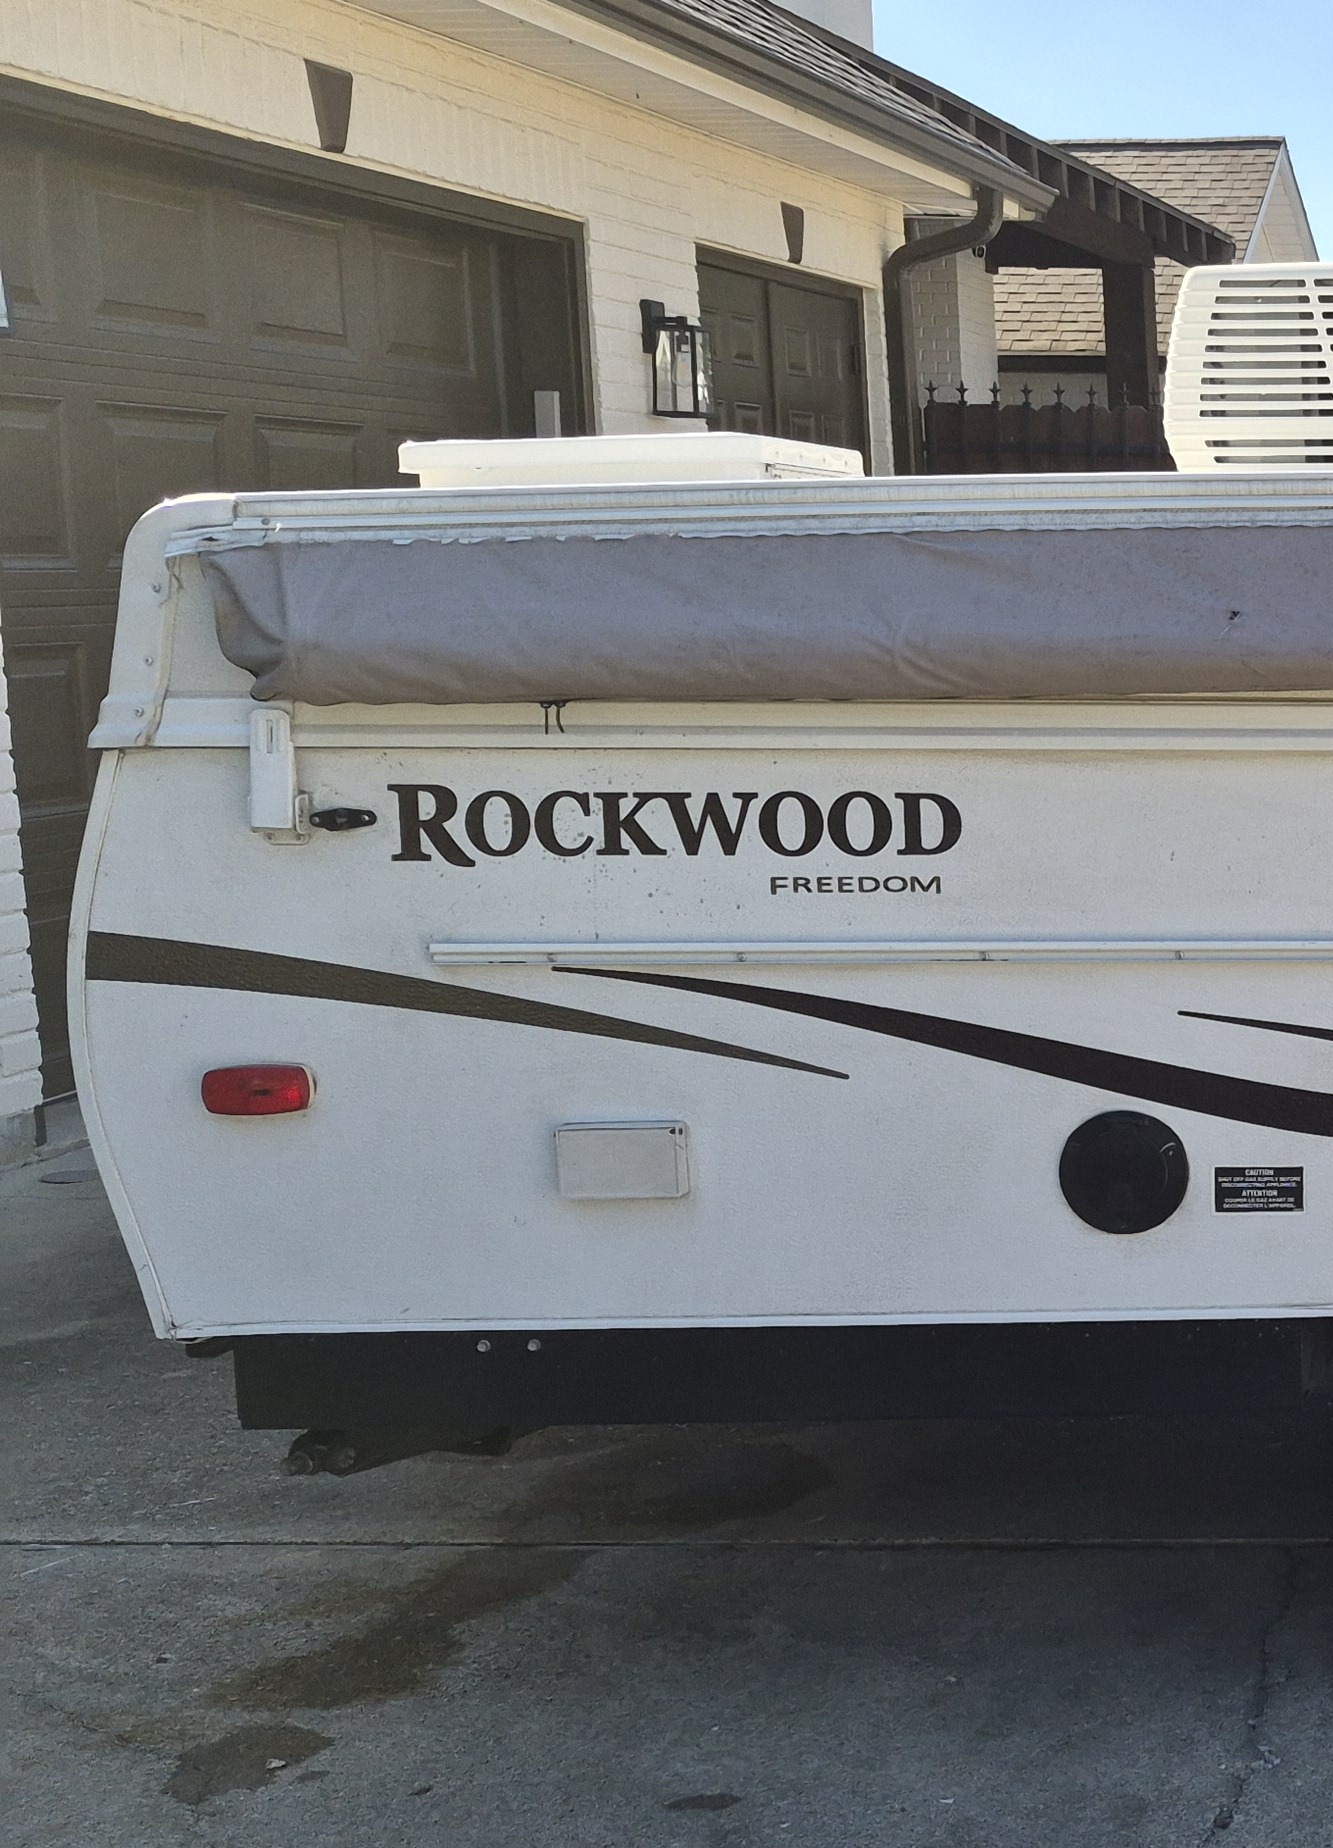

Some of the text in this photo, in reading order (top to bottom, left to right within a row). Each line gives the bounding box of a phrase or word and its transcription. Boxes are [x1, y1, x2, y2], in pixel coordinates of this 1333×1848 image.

[387, 784, 963, 868] ROCKWOOD
[769, 875, 942, 896] FREEDOM
[1241, 1189, 1278, 1197] ATTENTION
